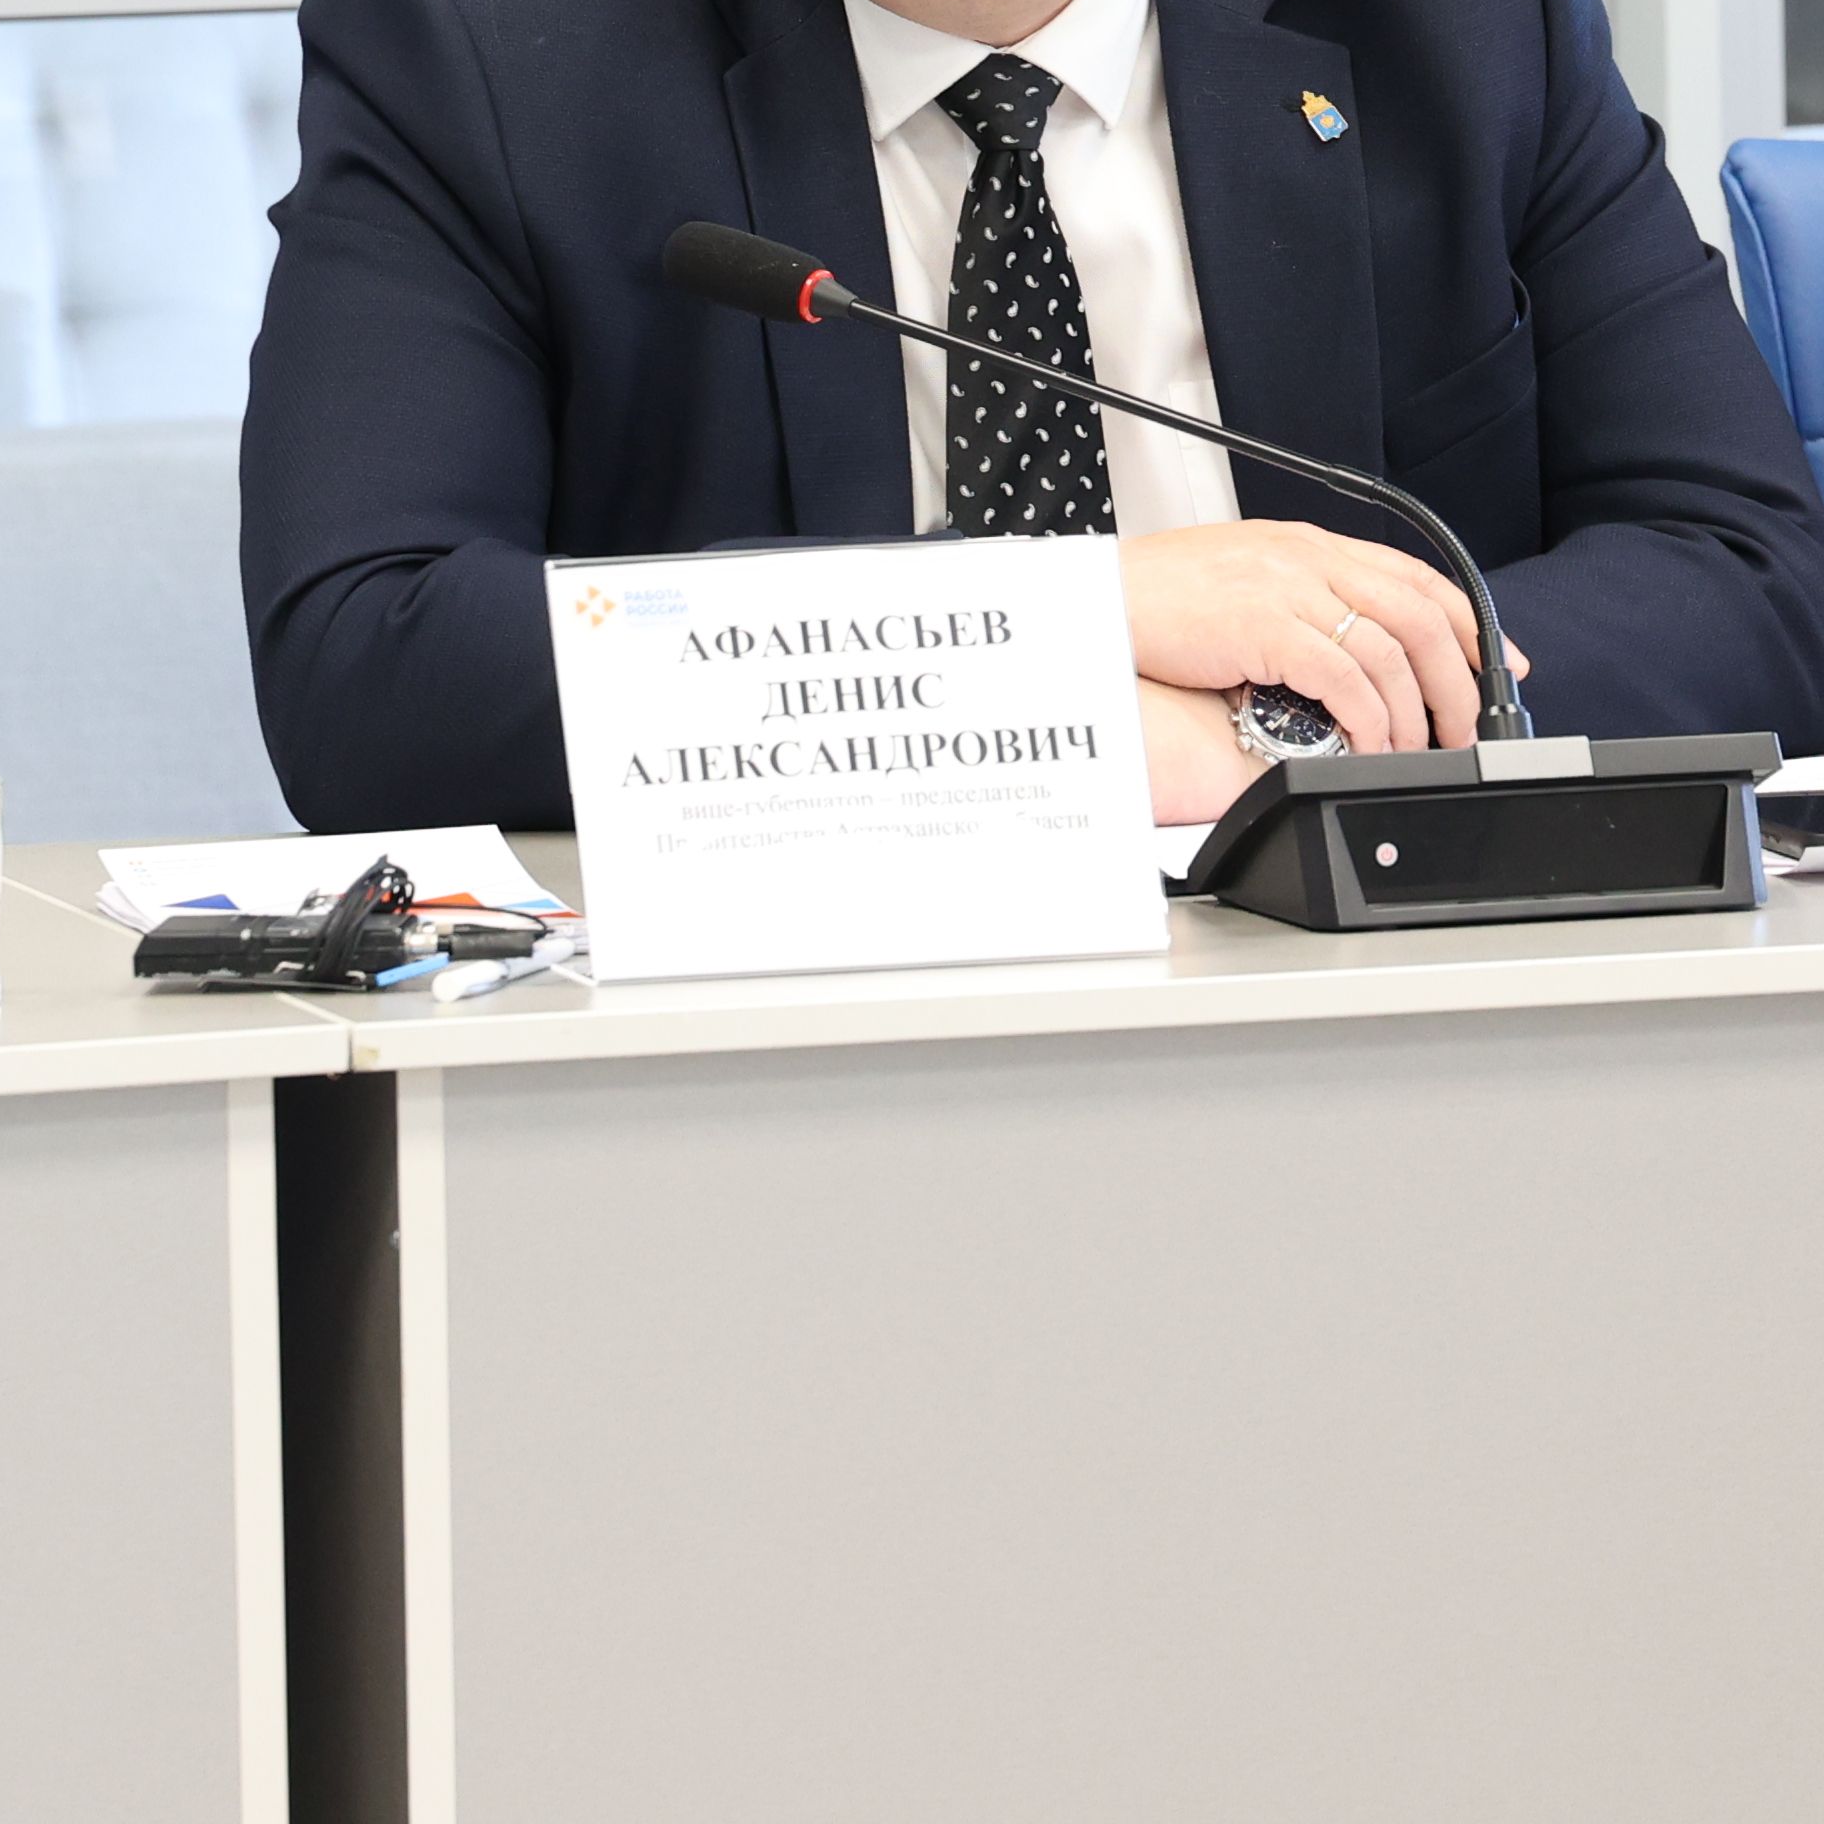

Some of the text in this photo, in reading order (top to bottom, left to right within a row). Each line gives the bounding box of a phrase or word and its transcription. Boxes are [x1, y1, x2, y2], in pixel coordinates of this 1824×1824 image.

[679, 609, 1013, 664] АФАНАСЬЕВ
[762, 672, 945, 722] ДЕНИС
[622, 724, 1101, 788] АЛЕКСАНДРОВИЧ
[900, 784, 1052, 807] председатель
